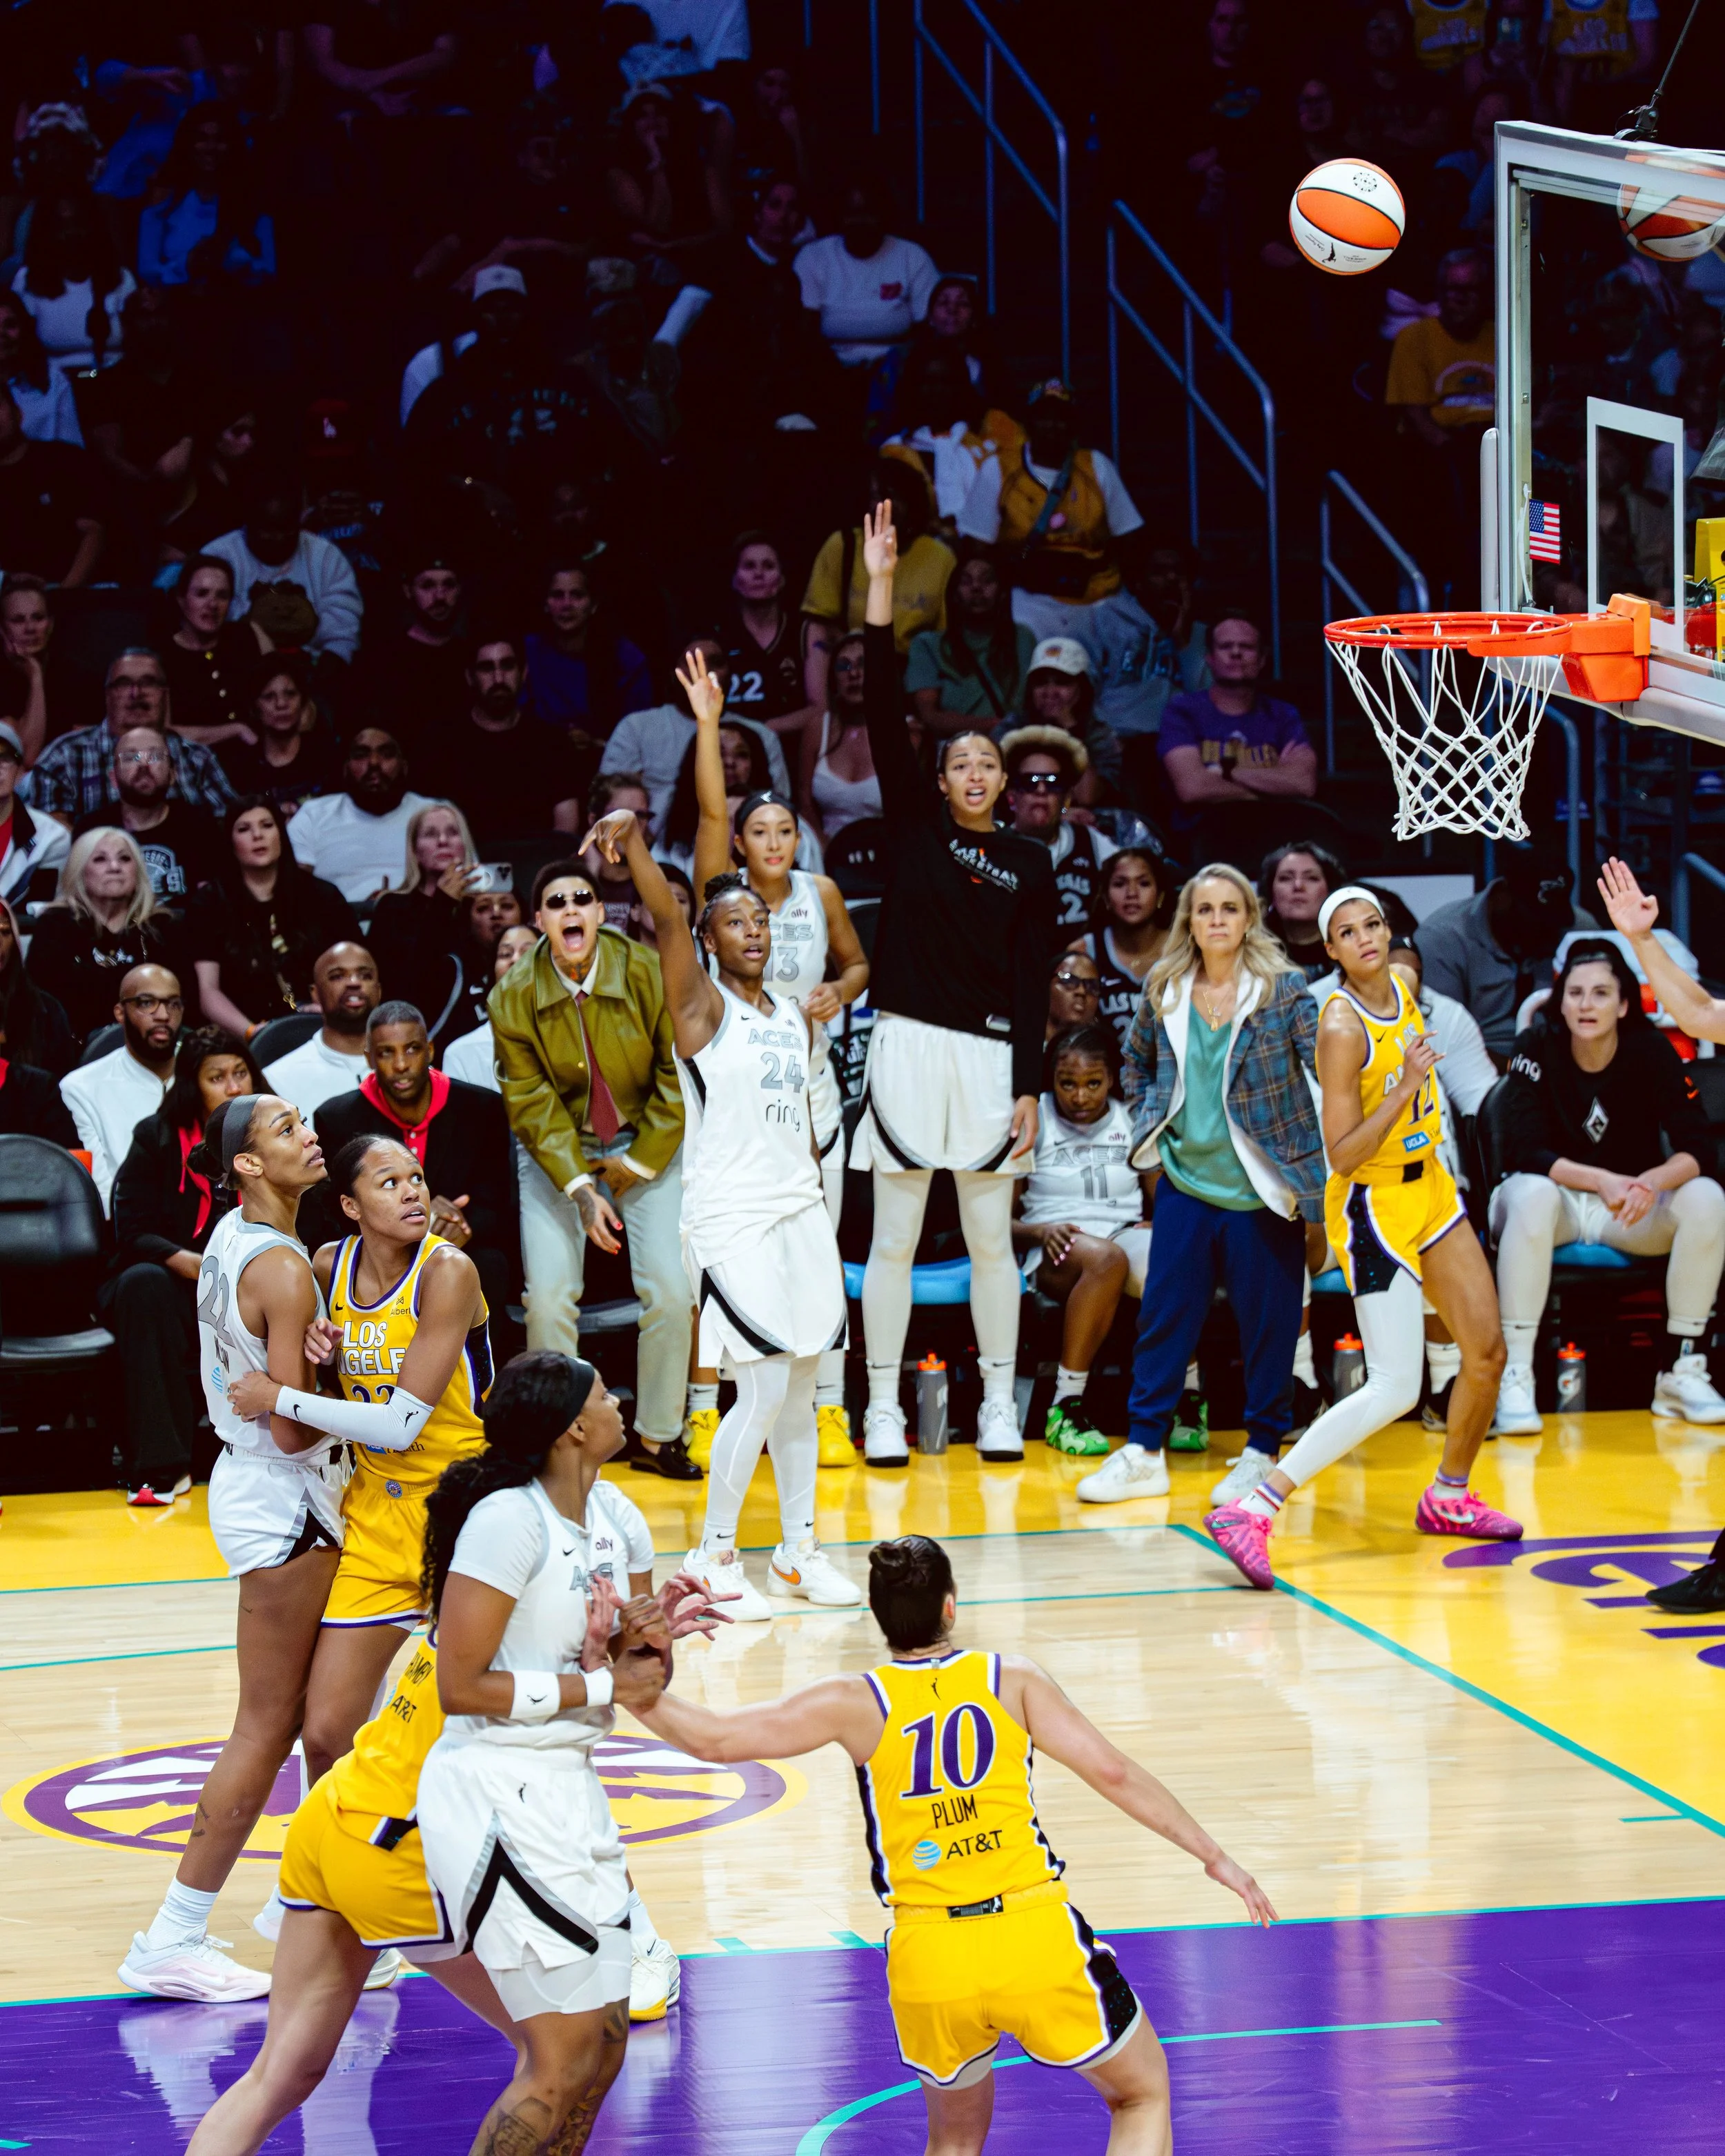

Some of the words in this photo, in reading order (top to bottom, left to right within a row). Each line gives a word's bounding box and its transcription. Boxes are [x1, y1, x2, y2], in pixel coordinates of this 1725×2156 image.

[791, 909, 808, 919] ally
[769, 924, 814, 941] CES
[763, 946, 799, 983] 13
[747, 1028, 804, 1051] ACES
[760, 1051, 805, 1094] 24
[1510, 1054, 1541, 1082] ring
[766, 1099, 800, 1133] ring
[1108, 1132, 1126, 1143] ally
[1405, 1135, 1427, 1149] UCLA
[1052, 1145, 1128, 1167] ACES
[1081, 1164, 1108, 1200] 11
[197, 1255, 237, 1350] 22
[342, 1321, 388, 1348] LOS
[337, 1347, 406, 1376] NGELE
[595, 1536, 613, 1552] ally
[569, 1562, 613, 1594] AS
[389, 1694, 417, 1723] A&T
[898, 1701, 997, 1800] 10
[931, 1794, 978, 1829] PLUM
[946, 1829, 1003, 1860] AT&T
